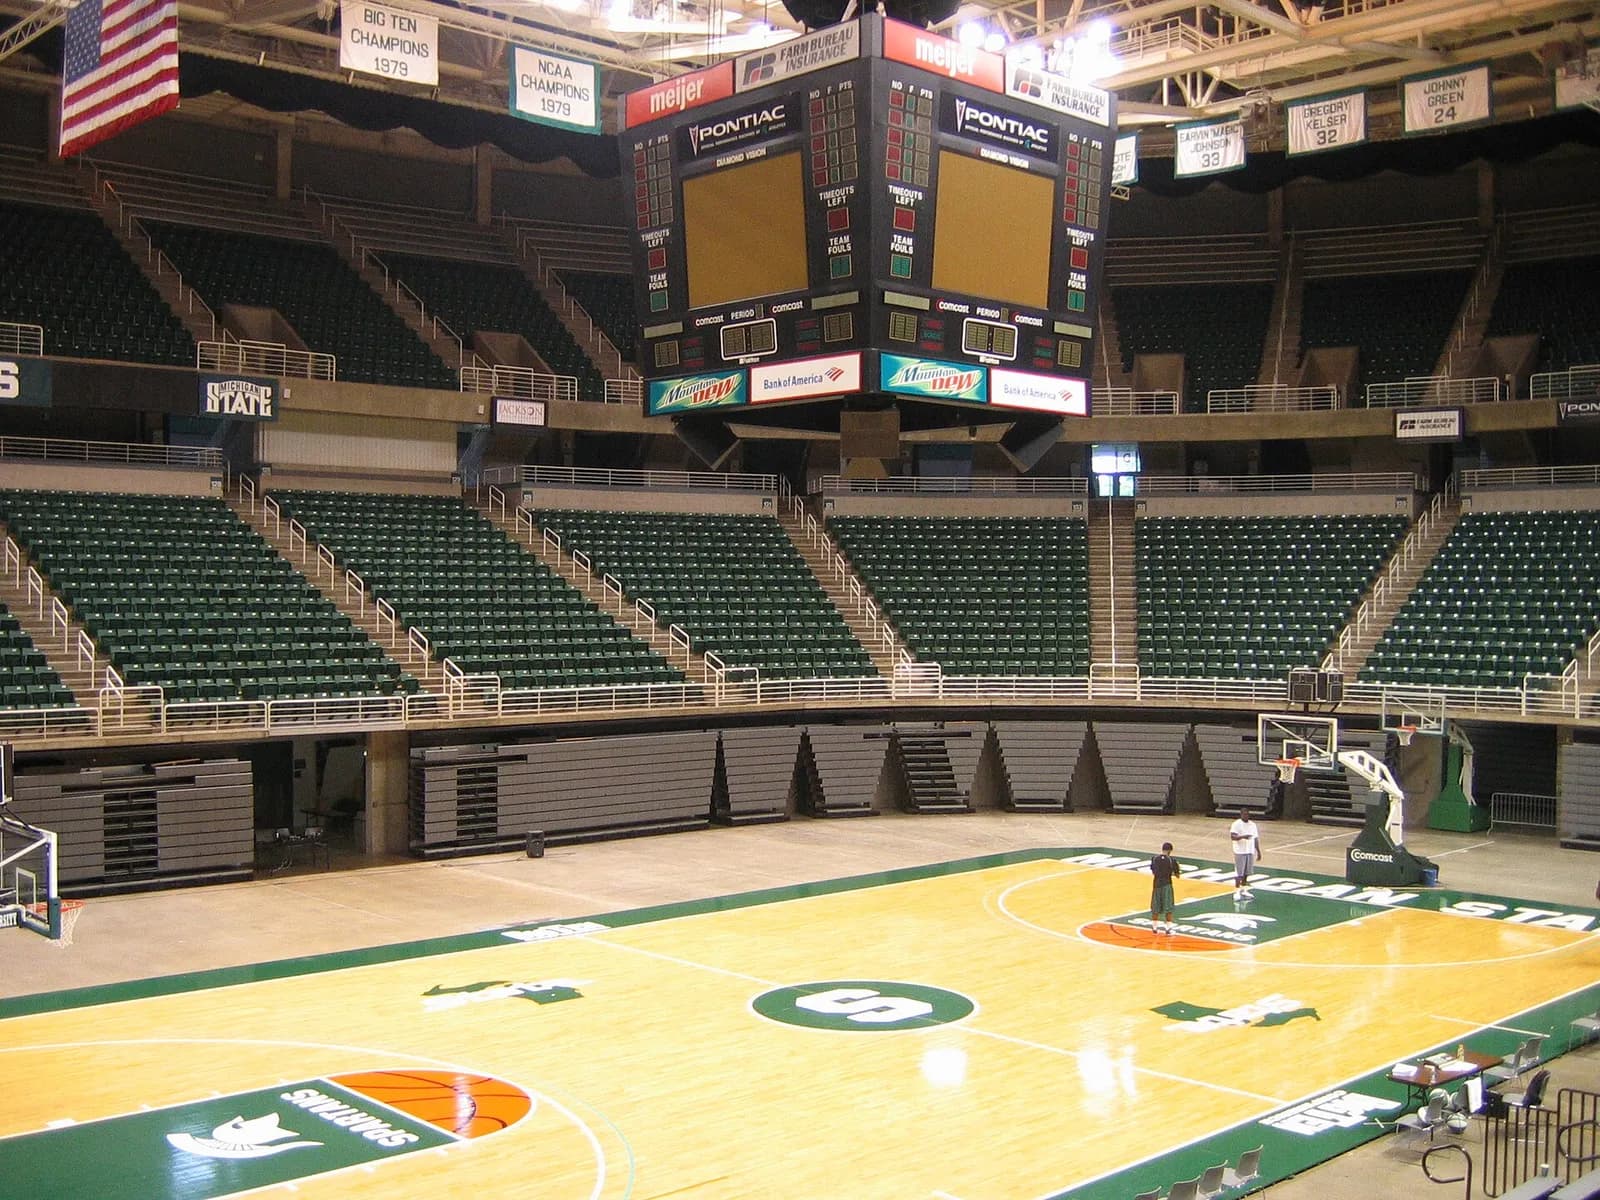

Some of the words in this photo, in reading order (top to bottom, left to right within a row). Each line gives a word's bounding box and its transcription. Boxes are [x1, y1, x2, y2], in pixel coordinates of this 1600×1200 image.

[364, 8, 386, 27] BIG
[390, 14, 417, 33] TEN
[350, 29, 429, 58] CHAMPIONS
[780, 41, 809, 60] FARM
[810, 27, 853, 51] BUREAU
[785, 42, 847, 72] INSURANCE
[915, 37, 975, 77] meijer
[374, 57, 408, 77] 1979
[538, 59, 573, 81] NCAA
[521, 73, 590, 102] CHAMPIONS
[839, 80, 853, 92] PTS
[891, 80, 903, 90] NO
[1424, 76, 1467, 95] JOHNNY
[650, 77, 705, 114] meijer
[1428, 91, 1464, 108] GREEN
[541, 98, 571, 117] 1979
[1051, 92, 1101, 118] INSURANCE
[1303, 100, 1350, 119] GREGORY
[699, 104, 785, 141] PONTIAC
[1305, 114, 1347, 131] KELSER
[1434, 106, 1457, 124] 24
[965, 107, 1049, 143] PONTIAC
[1180, 130, 1209, 142] EARVIN
[1316, 129, 1337, 146] 32
[746, 147, 767, 160] VISION
[1190, 139, 1231, 153] JOHNSON
[1201, 152, 1220, 168] 33
[819, 185, 855, 201] TIMEOUTS
[888, 184, 923, 201] TIMEOUTS
[827, 195, 847, 207] LEFT
[895, 195, 915, 207] LEFT
[641, 229, 670, 242] TIMEOUTS
[647, 237, 664, 248] LEFT
[829, 235, 850, 246] TEAM
[893, 234, 913, 246] TEAM
[1072, 237, 1088, 247] LEFT
[828, 243, 851, 255] FOULS
[890, 242, 914, 255] FOULS
[650, 272, 667, 283] TEAM
[1070, 271, 1086, 282] TEAM
[648, 280, 668, 290] FOULS
[1067, 279, 1087, 291] FOULS
[731, 309, 754, 320] PERIOD
[976, 307, 1000, 318] PERIOD
[219, 381, 260, 393] MICHIGAN
[764, 378, 782, 389] Bank
[783, 377, 791, 387] of
[792, 374, 823, 386] America
[206, 382, 273, 417] STATE
[1004, 384, 1021, 395] Bank
[1030, 389, 1056, 400] America
[795, 988, 934, 1022] S
[280, 1088, 420, 1147] SPARTANS
